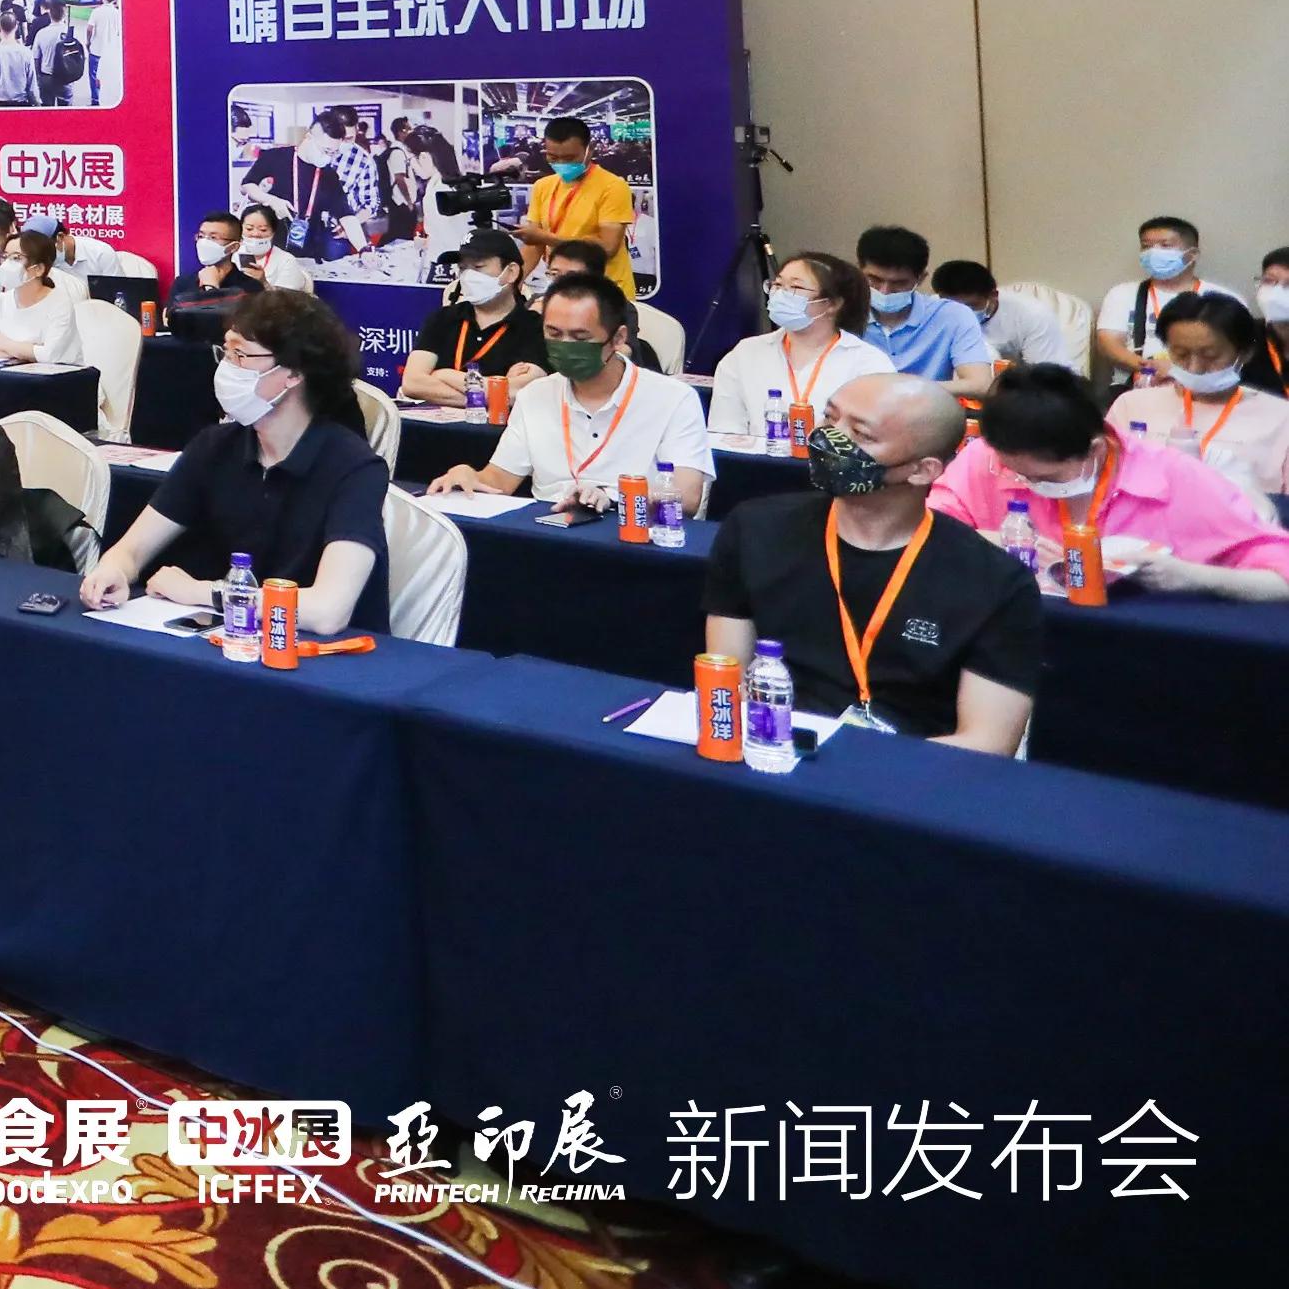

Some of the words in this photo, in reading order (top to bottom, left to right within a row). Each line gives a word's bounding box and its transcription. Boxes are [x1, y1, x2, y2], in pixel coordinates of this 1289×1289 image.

[8, 150, 116, 191] 中冰展
[69, 227, 96, 238] FOOD
[98, 229, 124, 239] EXPO
[358, 325, 419, 355] 深圳
[269, 605, 287, 651] 北冰洋
[711, 687, 733, 741] 北冰洋
